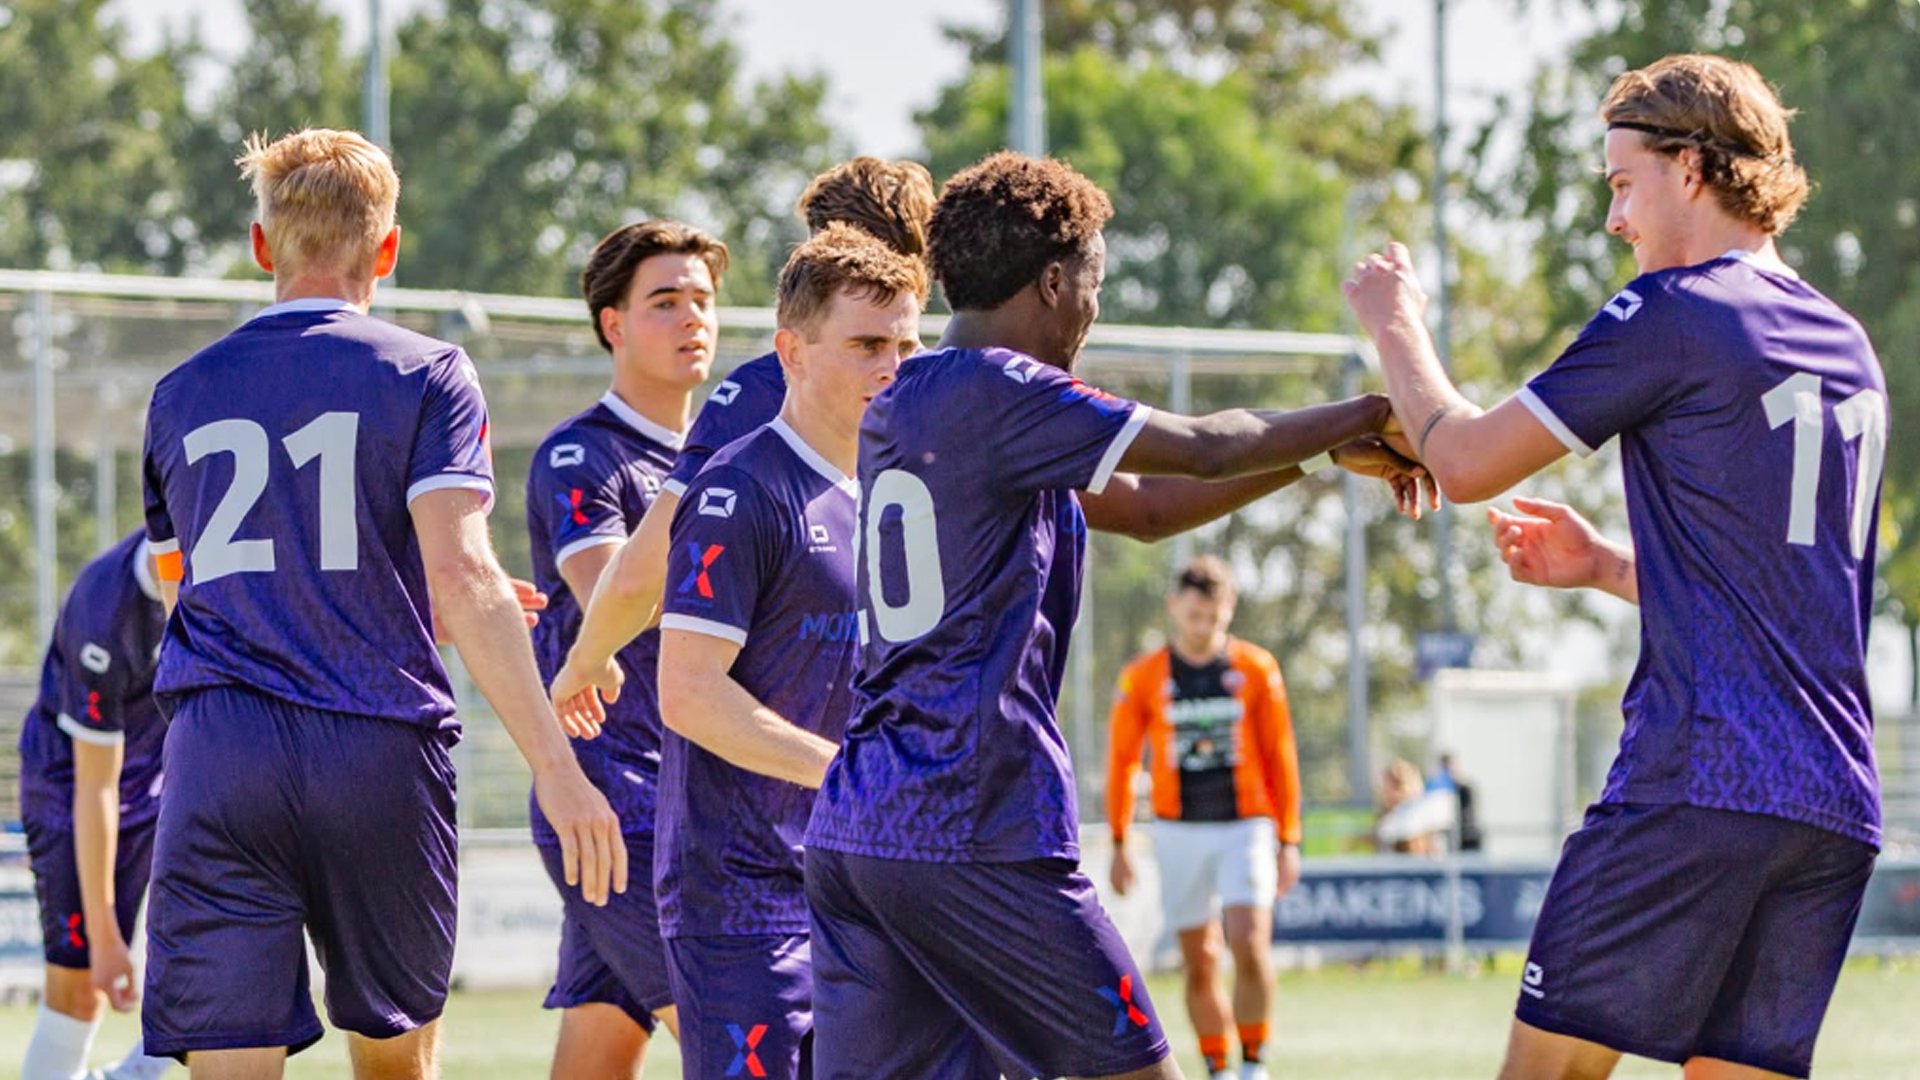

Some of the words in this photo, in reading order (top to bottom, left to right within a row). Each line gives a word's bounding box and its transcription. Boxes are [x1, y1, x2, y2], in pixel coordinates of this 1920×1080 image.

[183, 412, 359, 585] 21
[1761, 371, 1886, 561] 11
[851, 468, 945, 646] 0
